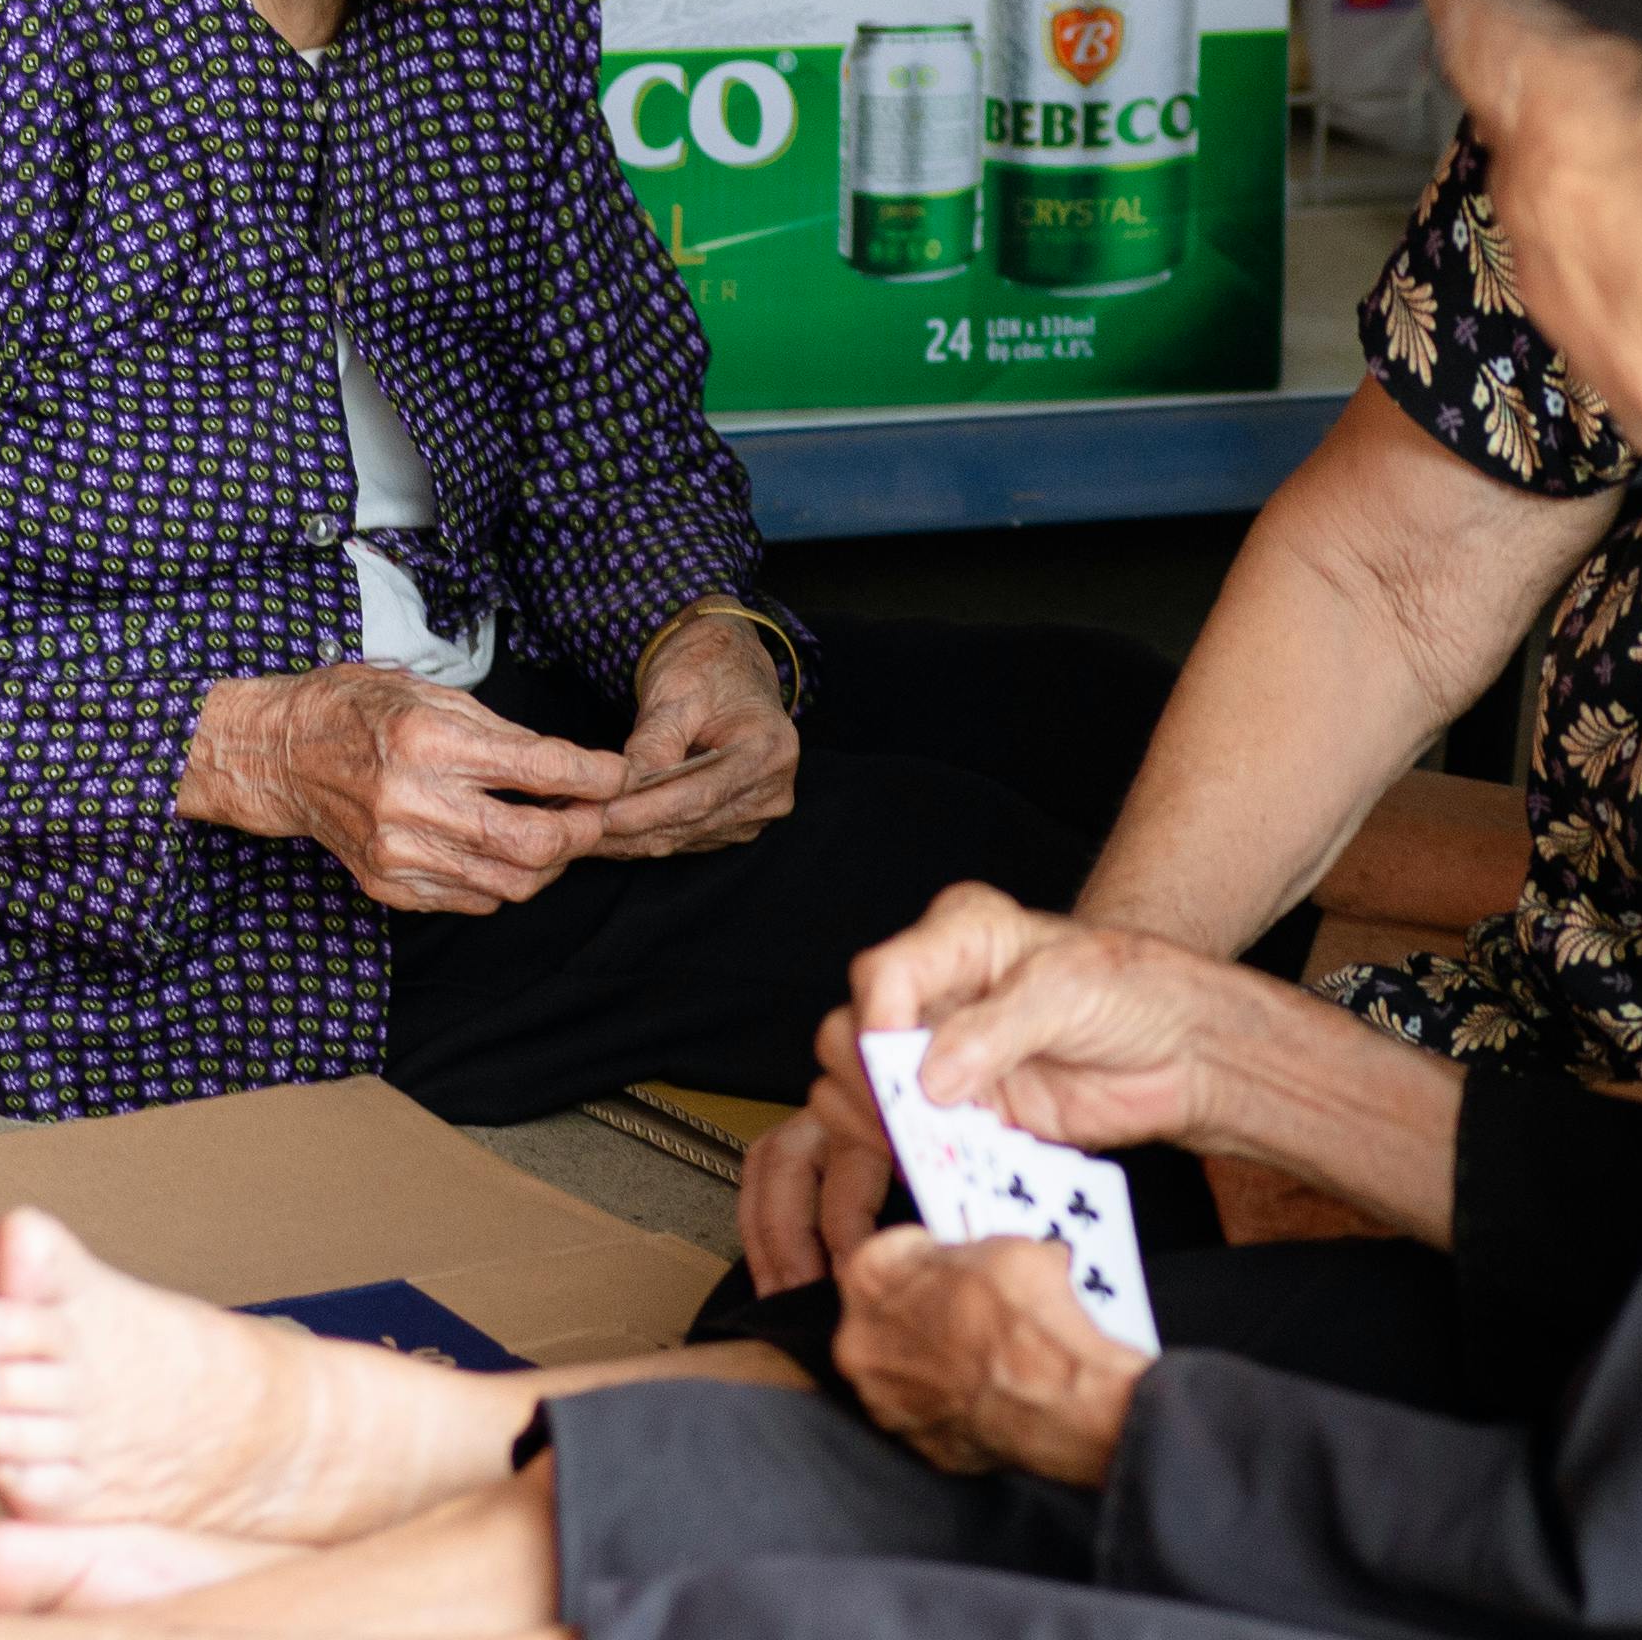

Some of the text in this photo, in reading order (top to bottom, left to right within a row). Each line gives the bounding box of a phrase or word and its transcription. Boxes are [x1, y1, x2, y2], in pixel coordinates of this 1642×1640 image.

[601, 59, 799, 172] CO
[984, 93, 1199, 151] BEBECO
[925, 317, 973, 362] 24
